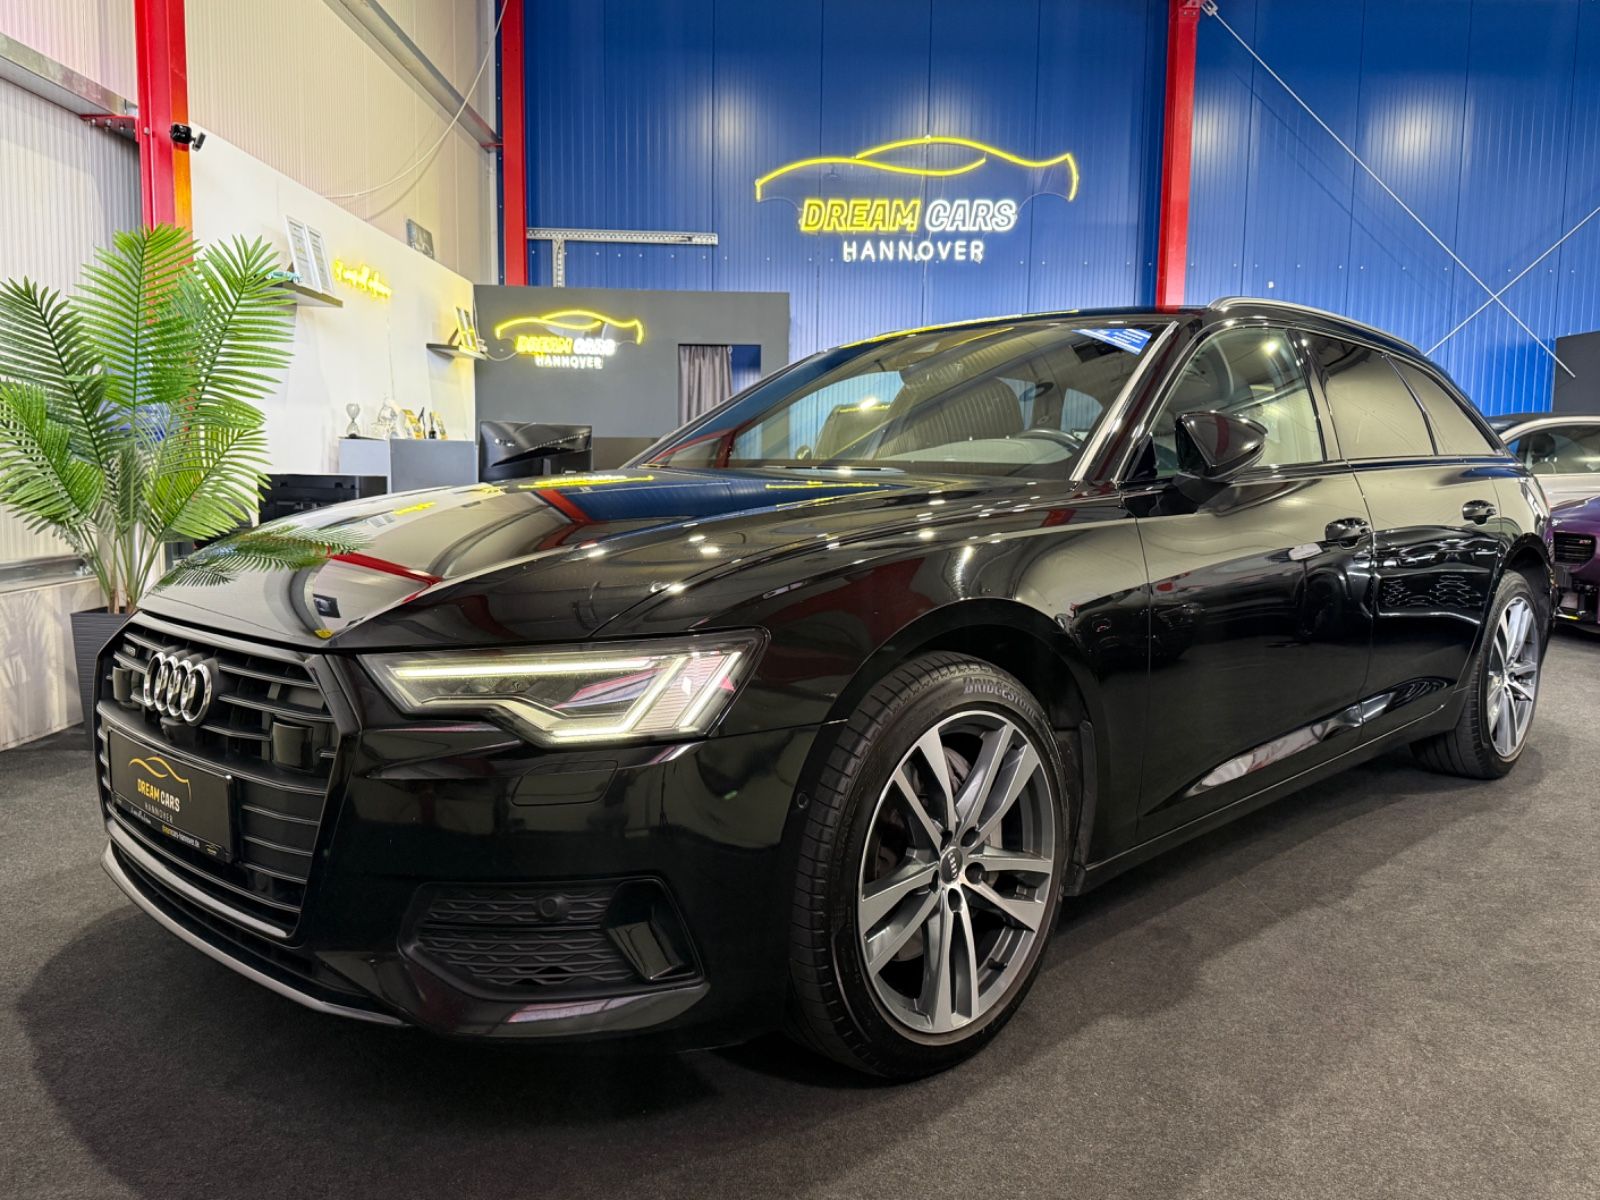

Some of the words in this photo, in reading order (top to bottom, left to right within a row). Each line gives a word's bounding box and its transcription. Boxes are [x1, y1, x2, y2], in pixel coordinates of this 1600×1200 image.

[800, 199, 921, 232] DREAM
[925, 199, 1017, 232] CARS
[843, 240, 985, 263] HANNOVER
[534, 355, 604, 369] HANNOVER
[137, 778, 160, 802] DREAM
[160, 791, 180, 812] CARS
